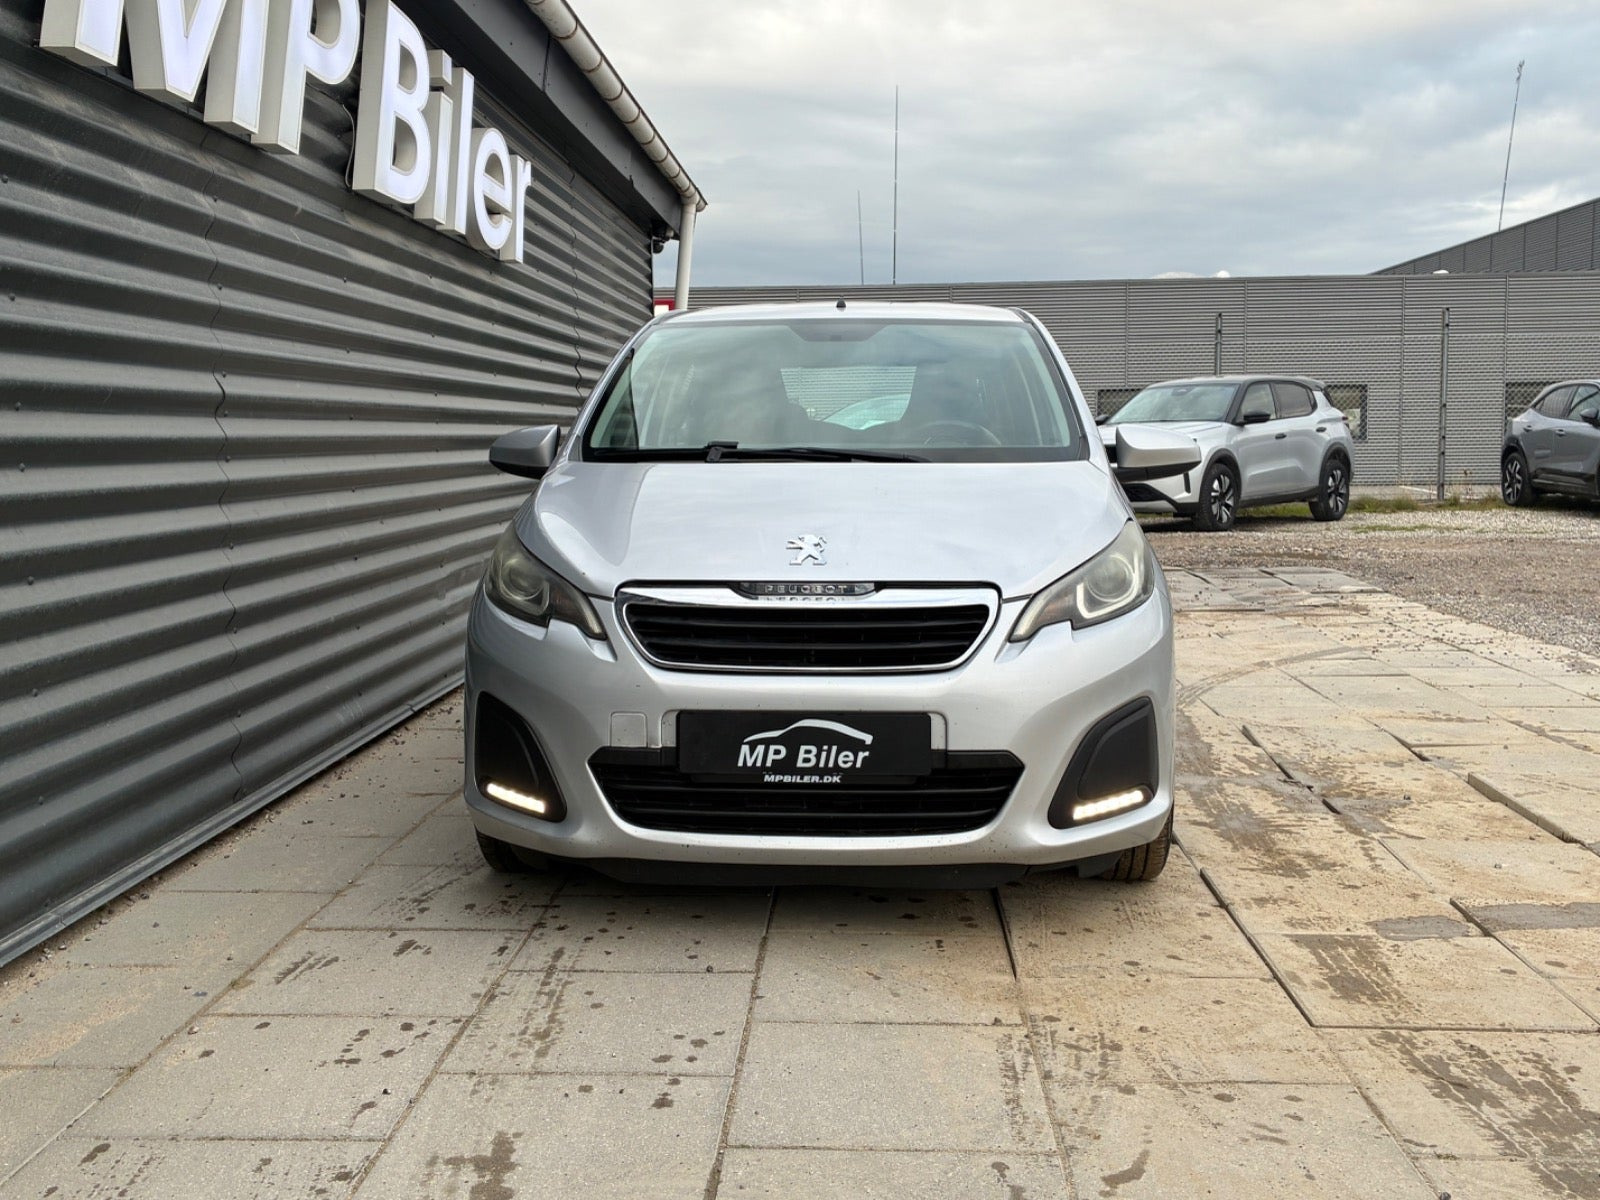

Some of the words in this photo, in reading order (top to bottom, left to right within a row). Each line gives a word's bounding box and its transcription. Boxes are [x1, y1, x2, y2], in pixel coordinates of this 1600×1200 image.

[354, 0, 532, 264] Biler
[764, 584, 848, 595] PEUGEOT
[737, 744, 787, 768] MP
[796, 745, 870, 769] Biler
[763, 774, 842, 784] MPBILER.DK
